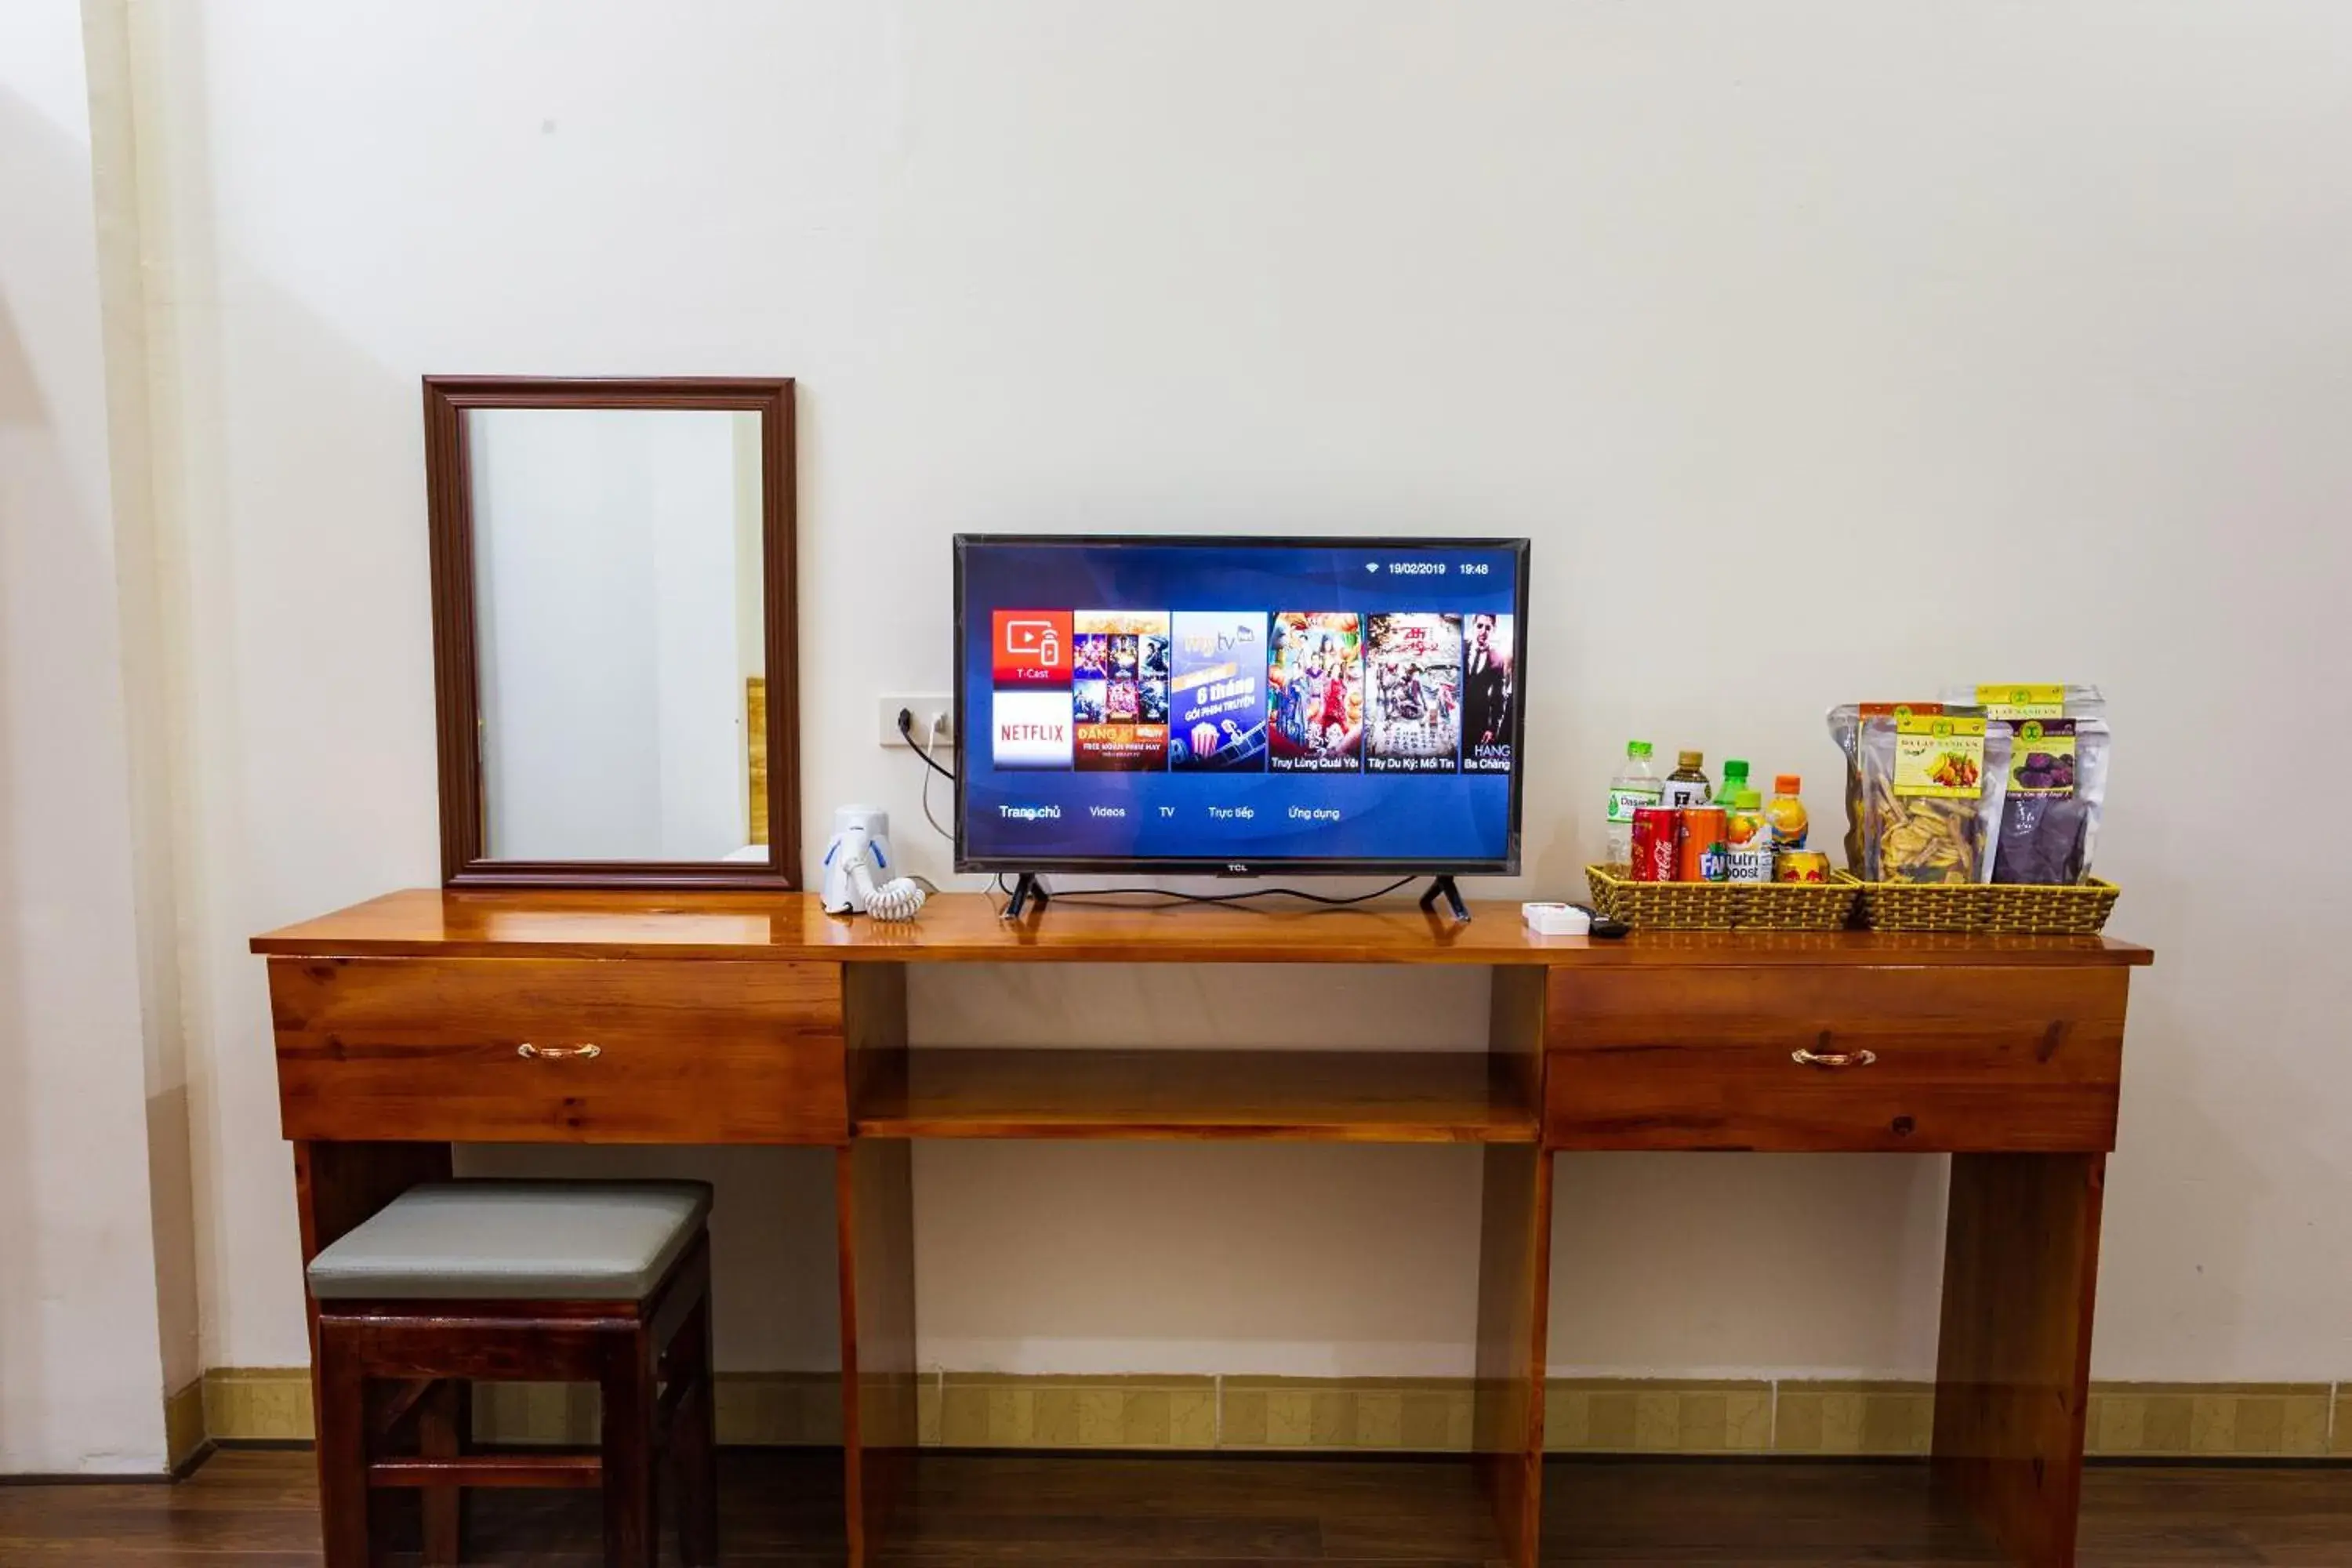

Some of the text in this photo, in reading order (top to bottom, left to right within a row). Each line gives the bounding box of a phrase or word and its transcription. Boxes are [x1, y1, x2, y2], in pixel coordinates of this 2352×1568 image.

[1017, 669, 1049, 678] T-Cast
[1197, 687, 1207, 705] 6
[1001, 724, 1064, 742] NETFLIX
[1388, 758, 1401, 768] Du
[999, 805, 1036, 820] Trang
[1089, 806, 1126, 817] Videos
[1159, 807, 1175, 818] TV
